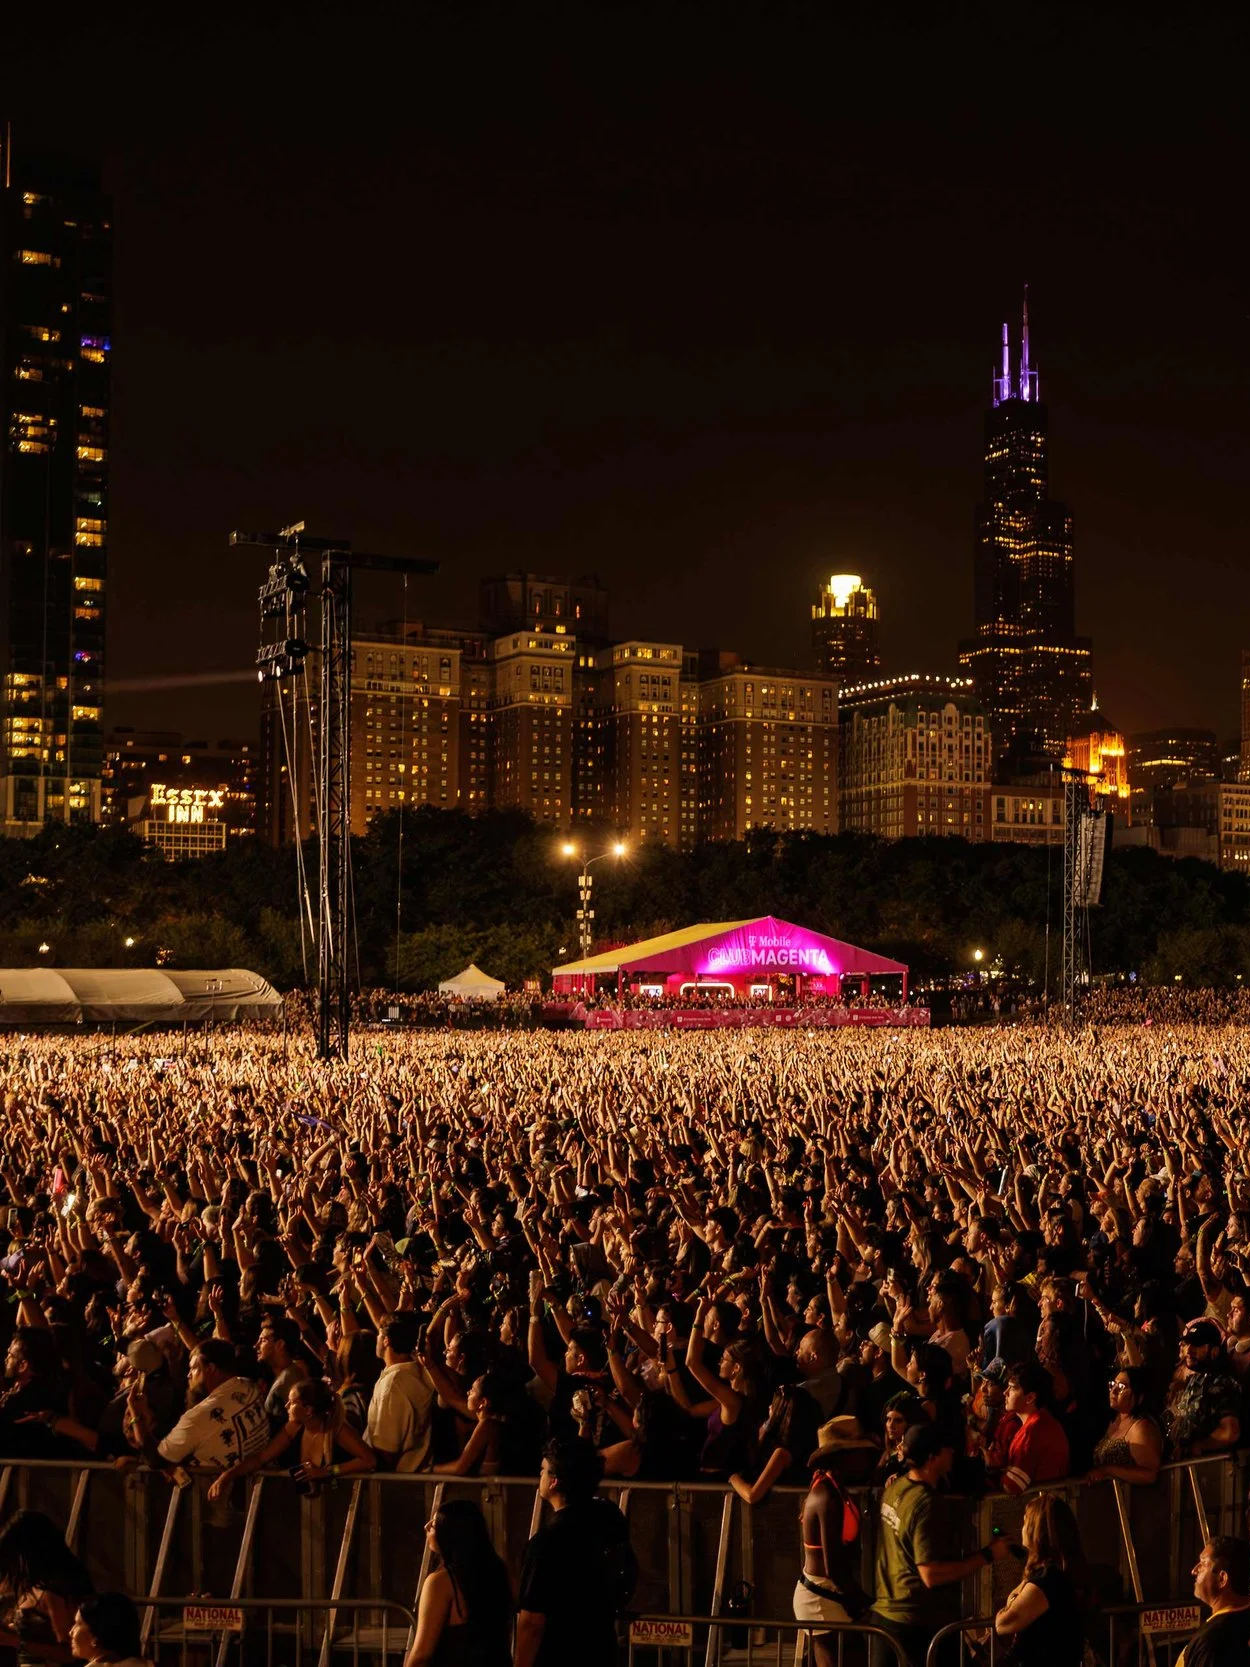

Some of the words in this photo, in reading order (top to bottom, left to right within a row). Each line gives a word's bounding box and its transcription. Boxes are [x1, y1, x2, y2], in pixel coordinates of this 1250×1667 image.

[168, 804, 204, 823] INN
[758, 935, 791, 947] Mobile
[186, 1607, 241, 1620] NATIONAL
[1143, 1606, 1198, 1623] NATIONAL
[632, 1621, 689, 1636] NATIONAL
